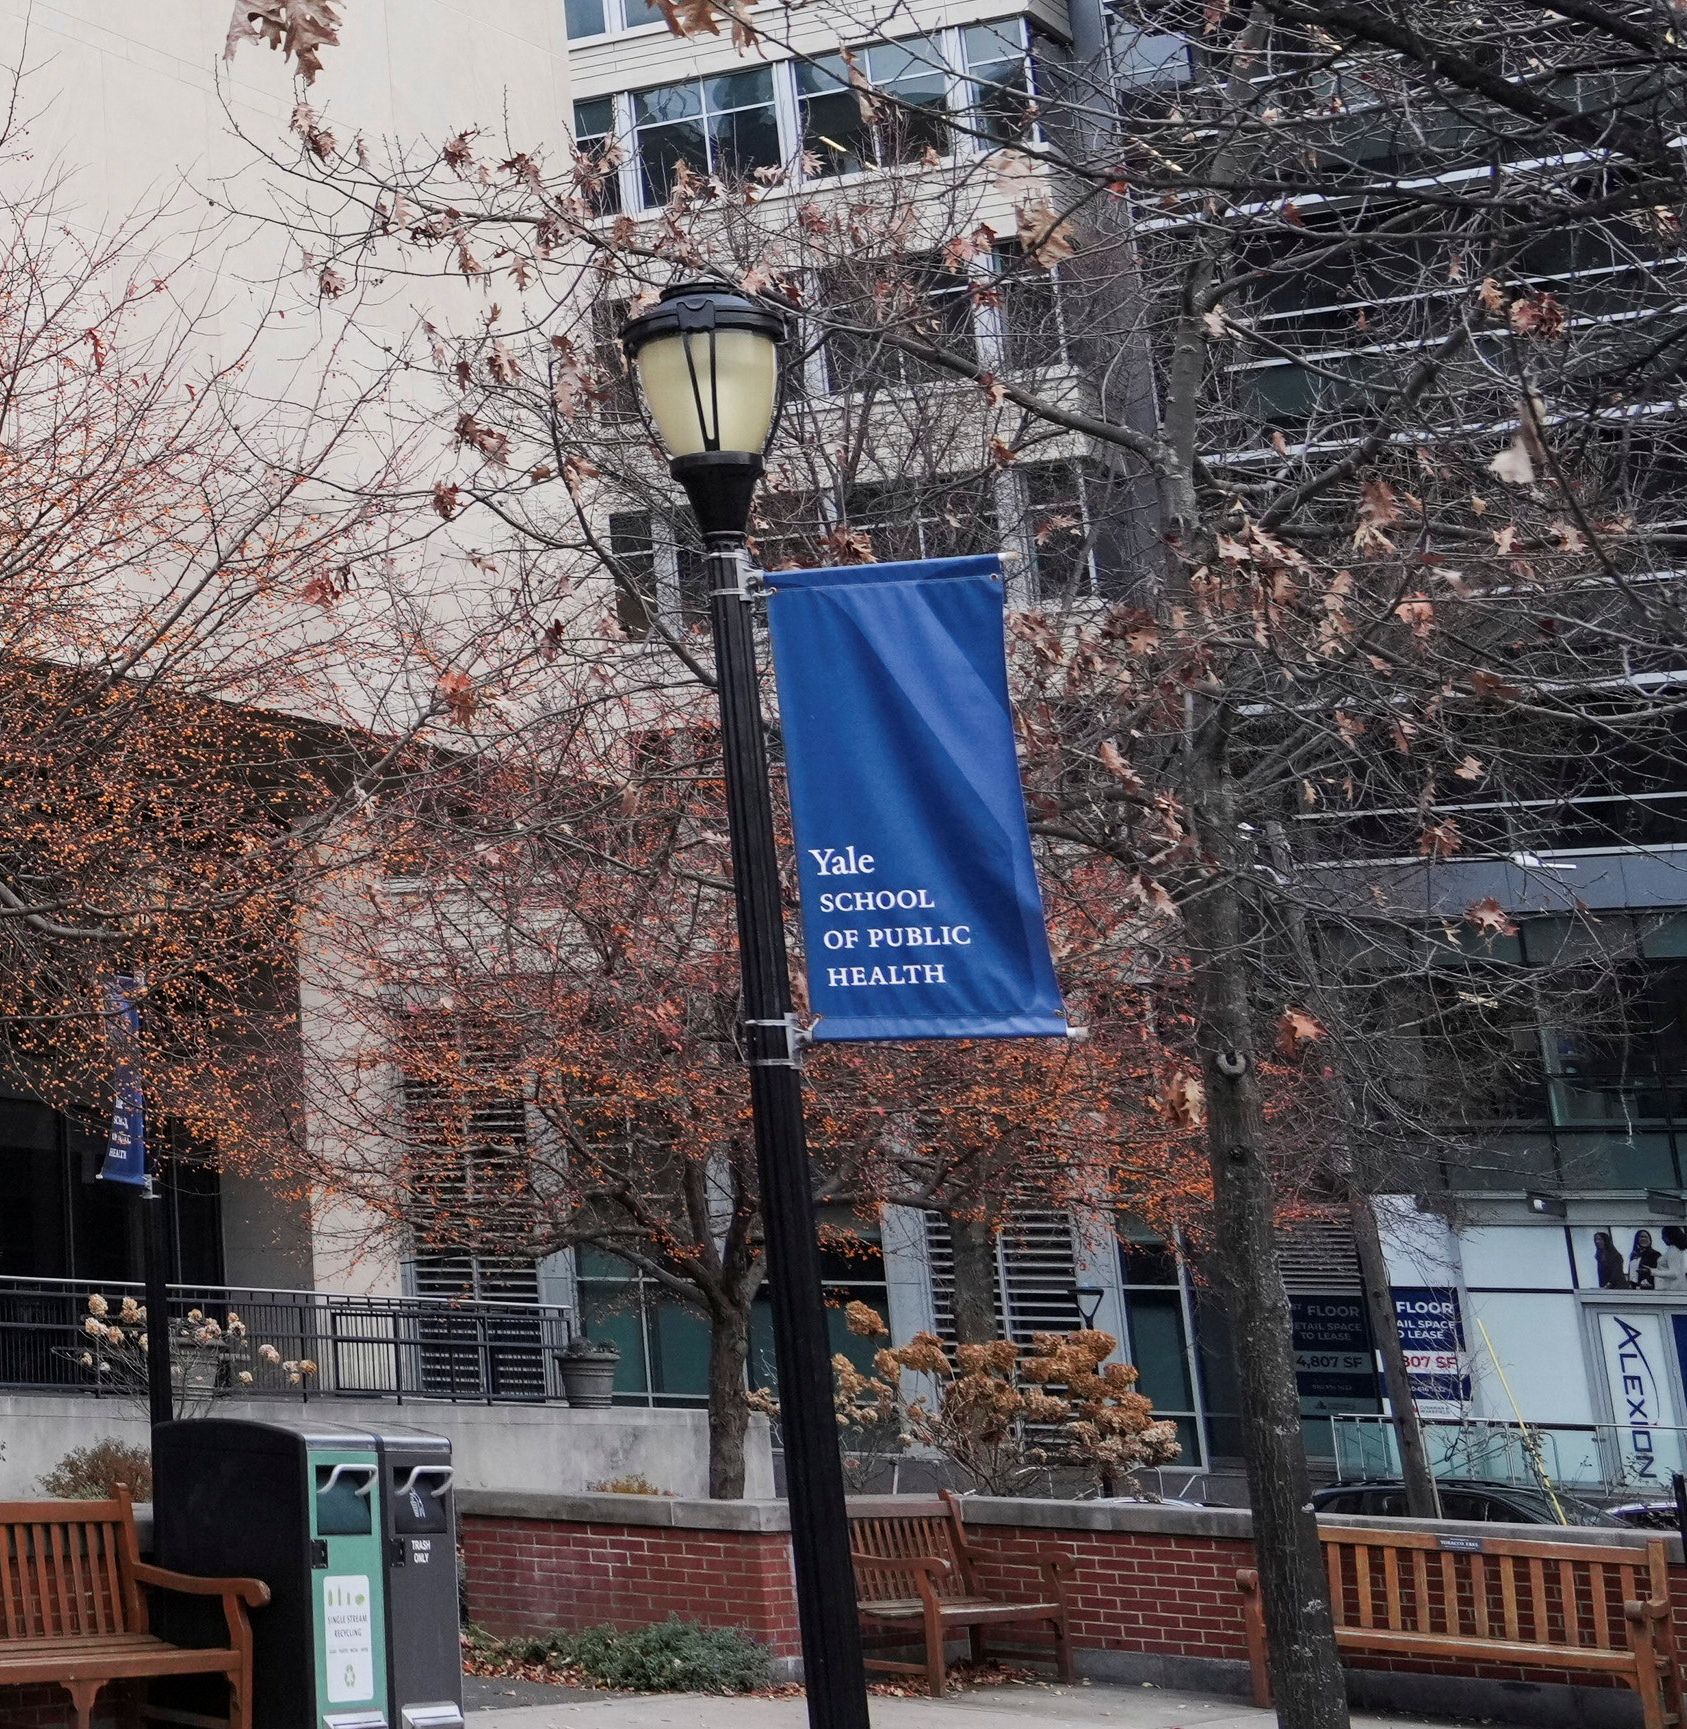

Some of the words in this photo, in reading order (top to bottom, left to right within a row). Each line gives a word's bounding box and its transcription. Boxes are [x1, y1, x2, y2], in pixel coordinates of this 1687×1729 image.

[809, 846, 875, 877] Yale
[820, 889, 935, 913] SCHOOL
[823, 929, 859, 951] OF
[868, 925, 971, 948] PUBLIC
[828, 964, 946, 987] HEALTH
[1307, 1305, 1360, 1317] FLOOR
[1396, 1301, 1454, 1314] FLOOR
[1293, 1322, 1325, 1331] ETAIL
[1327, 1323, 1363, 1332] SPACE
[1397, 1319, 1416, 1328] AIL
[1418, 1320, 1455, 1330] SPACE
[1301, 1332, 1315, 1340] TO
[1318, 1332, 1353, 1341] LEASE
[1408, 1330, 1444, 1339] LEASE
[1296, 1355, 1338, 1370] 4,807
[1343, 1355, 1363, 1369] SF
[1403, 1356, 1431, 1368] 807
[1436, 1356, 1457, 1369] SF
[1613, 1316, 1659, 1479] ALEXION
[411, 1539, 431, 1551] TRASH
[413, 1552, 430, 1564] ONLY
[328, 1616, 346, 1625] SINGLE
[346, 1615, 368, 1624] STREAM
[334, 1628, 362, 1638] RECYCLING
